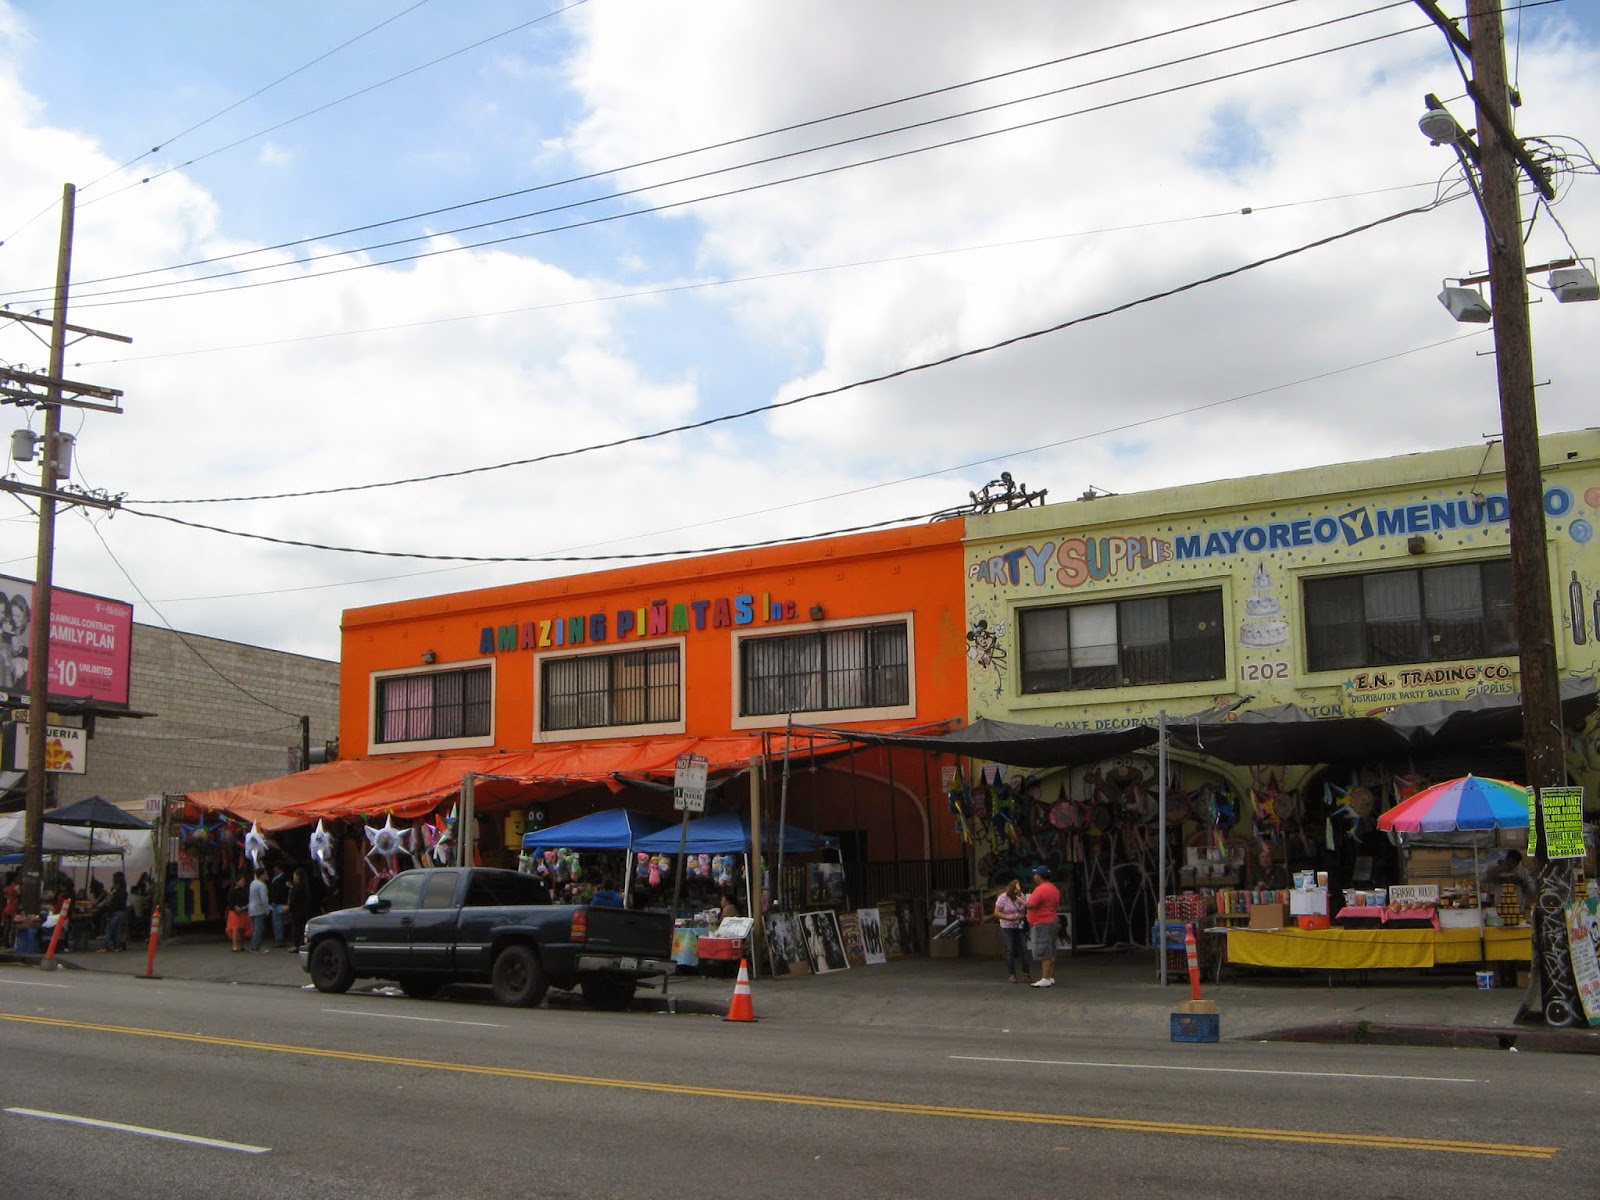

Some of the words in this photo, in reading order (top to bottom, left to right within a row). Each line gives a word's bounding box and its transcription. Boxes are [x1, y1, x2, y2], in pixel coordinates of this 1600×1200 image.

[1175, 516, 1338, 560] MAYOREO
[1340, 508, 1370, 542] Y
[1376, 489, 1569, 535] MENUDO
[968, 541, 1056, 586] PARTY
[1056, 536, 1174, 588] SUPPLIES
[55, 614, 81, 626] ANNUAL
[82, 619, 115, 632] CONTRACT
[480, 613, 607, 654] AMAZING
[617, 594, 754, 638] PIÑATAS
[762, 592, 799, 621] Inc.
[50, 624, 85, 643] AMILY
[86, 631, 115, 650] PLAN
[79, 664, 113, 676] UNLIMITED
[1240, 662, 1289, 681] 1202
[1355, 673, 1394, 690] E.N.
[1399, 665, 1477, 686] TRADING
[1483, 664, 1513, 681] CO.
[1351, 692, 1397, 704] DISTRIBUTOR
[1399, 690, 1425, 700] PARTY
[1428, 687, 1461, 698] BAKERY
[25, 727, 79, 739] TUERIA
